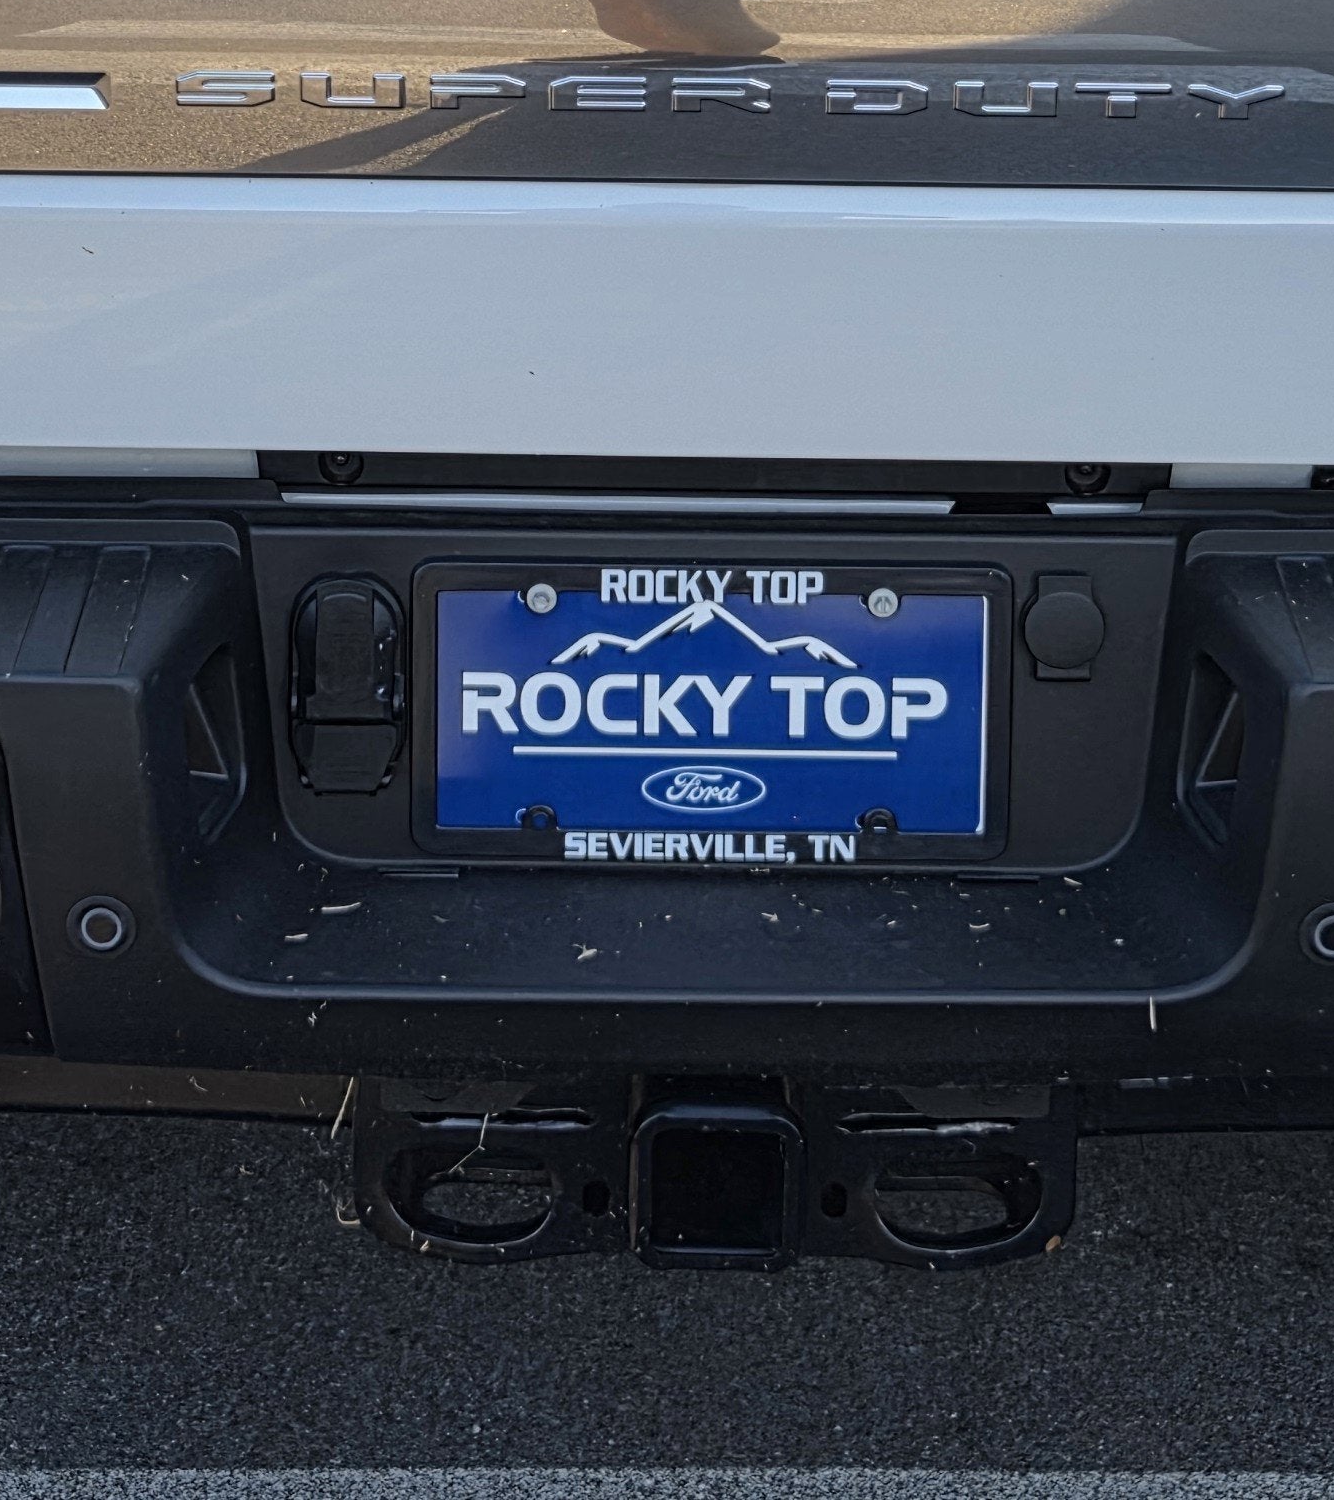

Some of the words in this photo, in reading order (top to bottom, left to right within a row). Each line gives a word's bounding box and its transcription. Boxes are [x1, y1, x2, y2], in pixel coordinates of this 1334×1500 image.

[175, 69, 772, 114] SUPER
[826, 77, 1285, 119] DUTY
[600, 568, 733, 604] ROCKY
[745, 570, 824, 605] TOP
[462, 670, 753, 737] ROCKY
[770, 675, 949, 740] TOP
[665, 771, 742, 804] Ford
[563, 831, 797, 864] SEVIERVILLE,
[807, 834, 857, 862] TN
